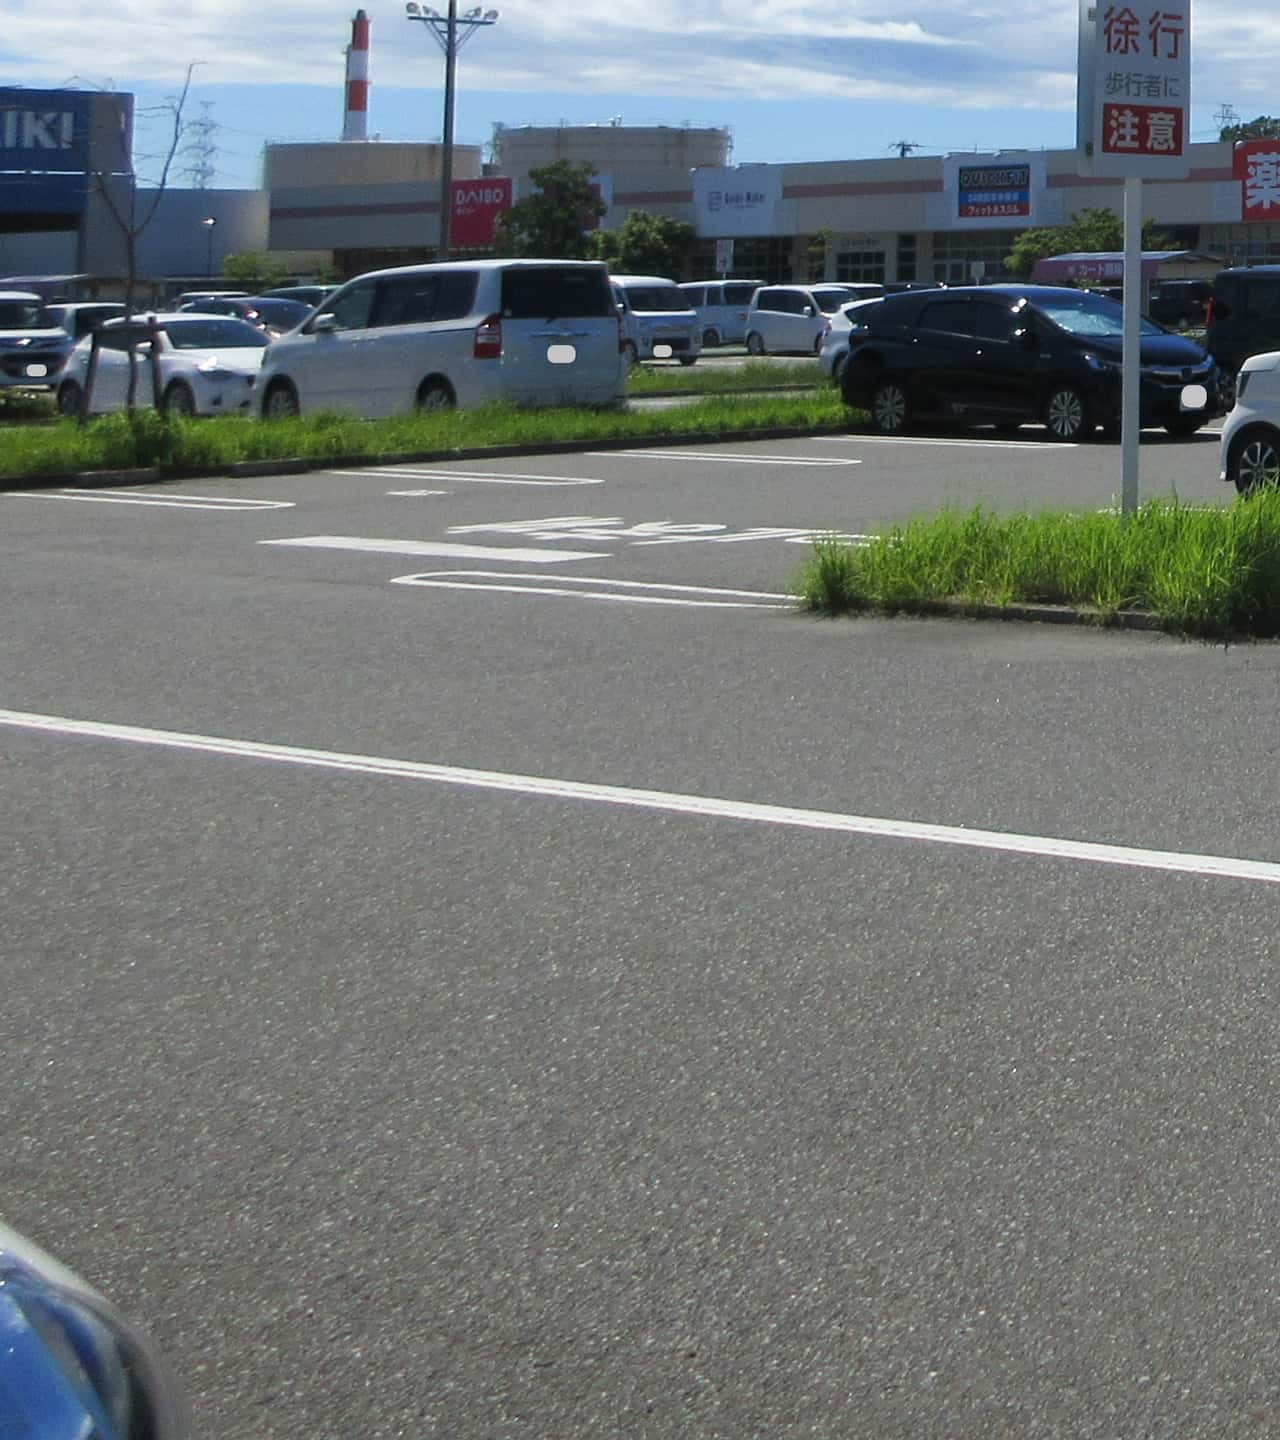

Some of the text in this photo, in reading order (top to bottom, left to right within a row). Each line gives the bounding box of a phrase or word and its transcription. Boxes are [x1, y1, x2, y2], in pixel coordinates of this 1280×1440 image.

[1104, 6, 1184, 59] 徐行
[1106, 72, 1180, 98] 歩行者に
[0, 111, 74, 150] IKI
[1109, 109, 1177, 151] 注意
[456, 188, 504, 205] DAISO
